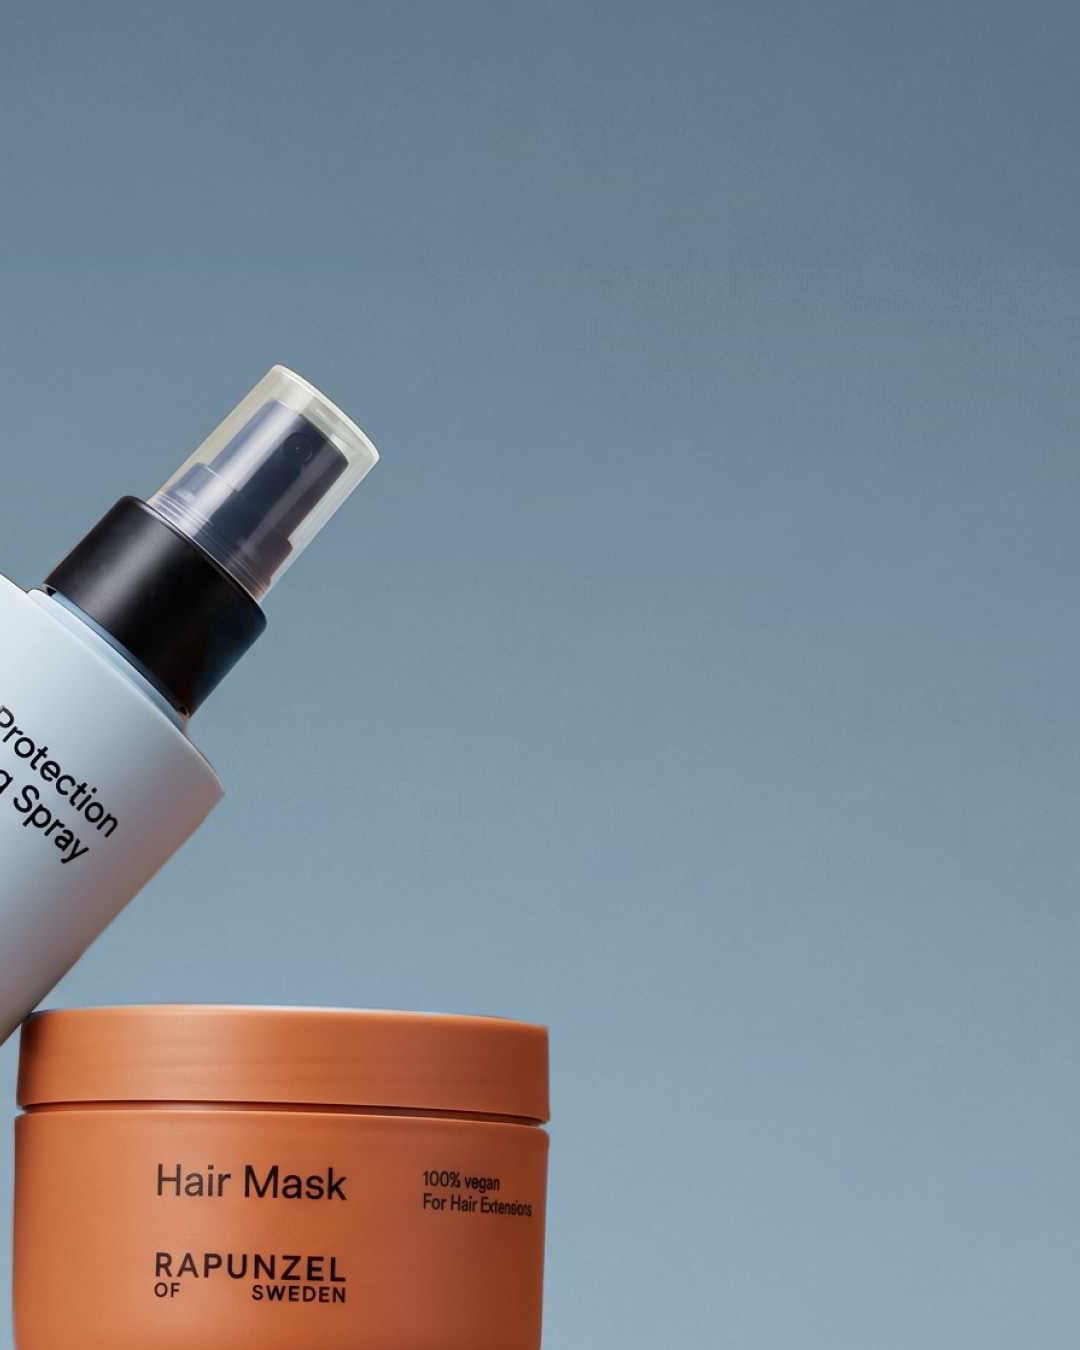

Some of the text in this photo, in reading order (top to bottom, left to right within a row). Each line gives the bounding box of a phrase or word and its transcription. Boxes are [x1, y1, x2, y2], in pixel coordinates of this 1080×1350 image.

[12, 785, 90, 864] Spray
[156, 1163, 347, 1200] Hair Mask
[422, 1170, 500, 1193] 100% vegan
[422, 1193, 446, 1211] For
[450, 1194, 478, 1213] Hair
[155, 1251, 346, 1283] RAPUNZEL
[154, 1282, 346, 1303] OF SWEDEN
